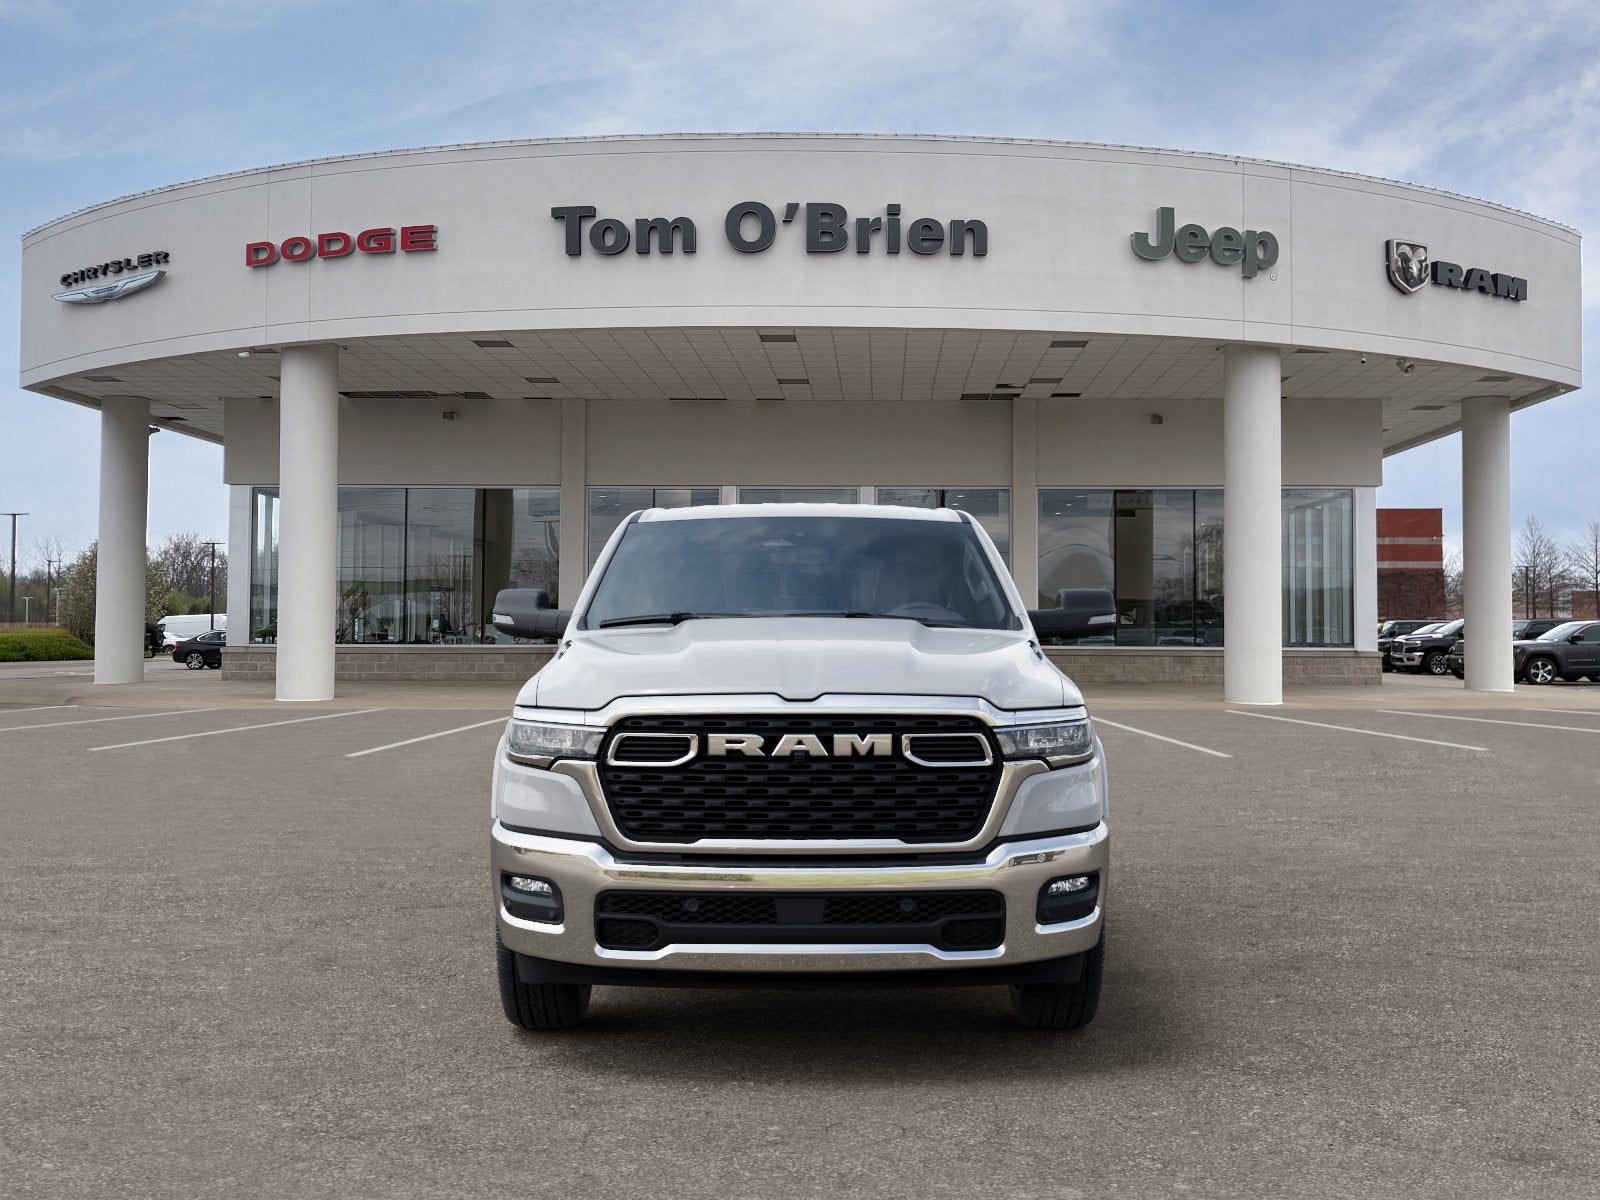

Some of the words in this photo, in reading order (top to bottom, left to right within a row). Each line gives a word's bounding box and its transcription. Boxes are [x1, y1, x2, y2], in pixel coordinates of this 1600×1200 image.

[245, 224, 438, 269] DODGE
[551, 206, 696, 256] Tom
[725, 201, 988, 256] O'Brien
[1130, 207, 1279, 279] Jeep
[60, 250, 169, 287] CHRYSLER
[1430, 261, 1528, 301] RAM
[707, 733, 893, 757] RAM
